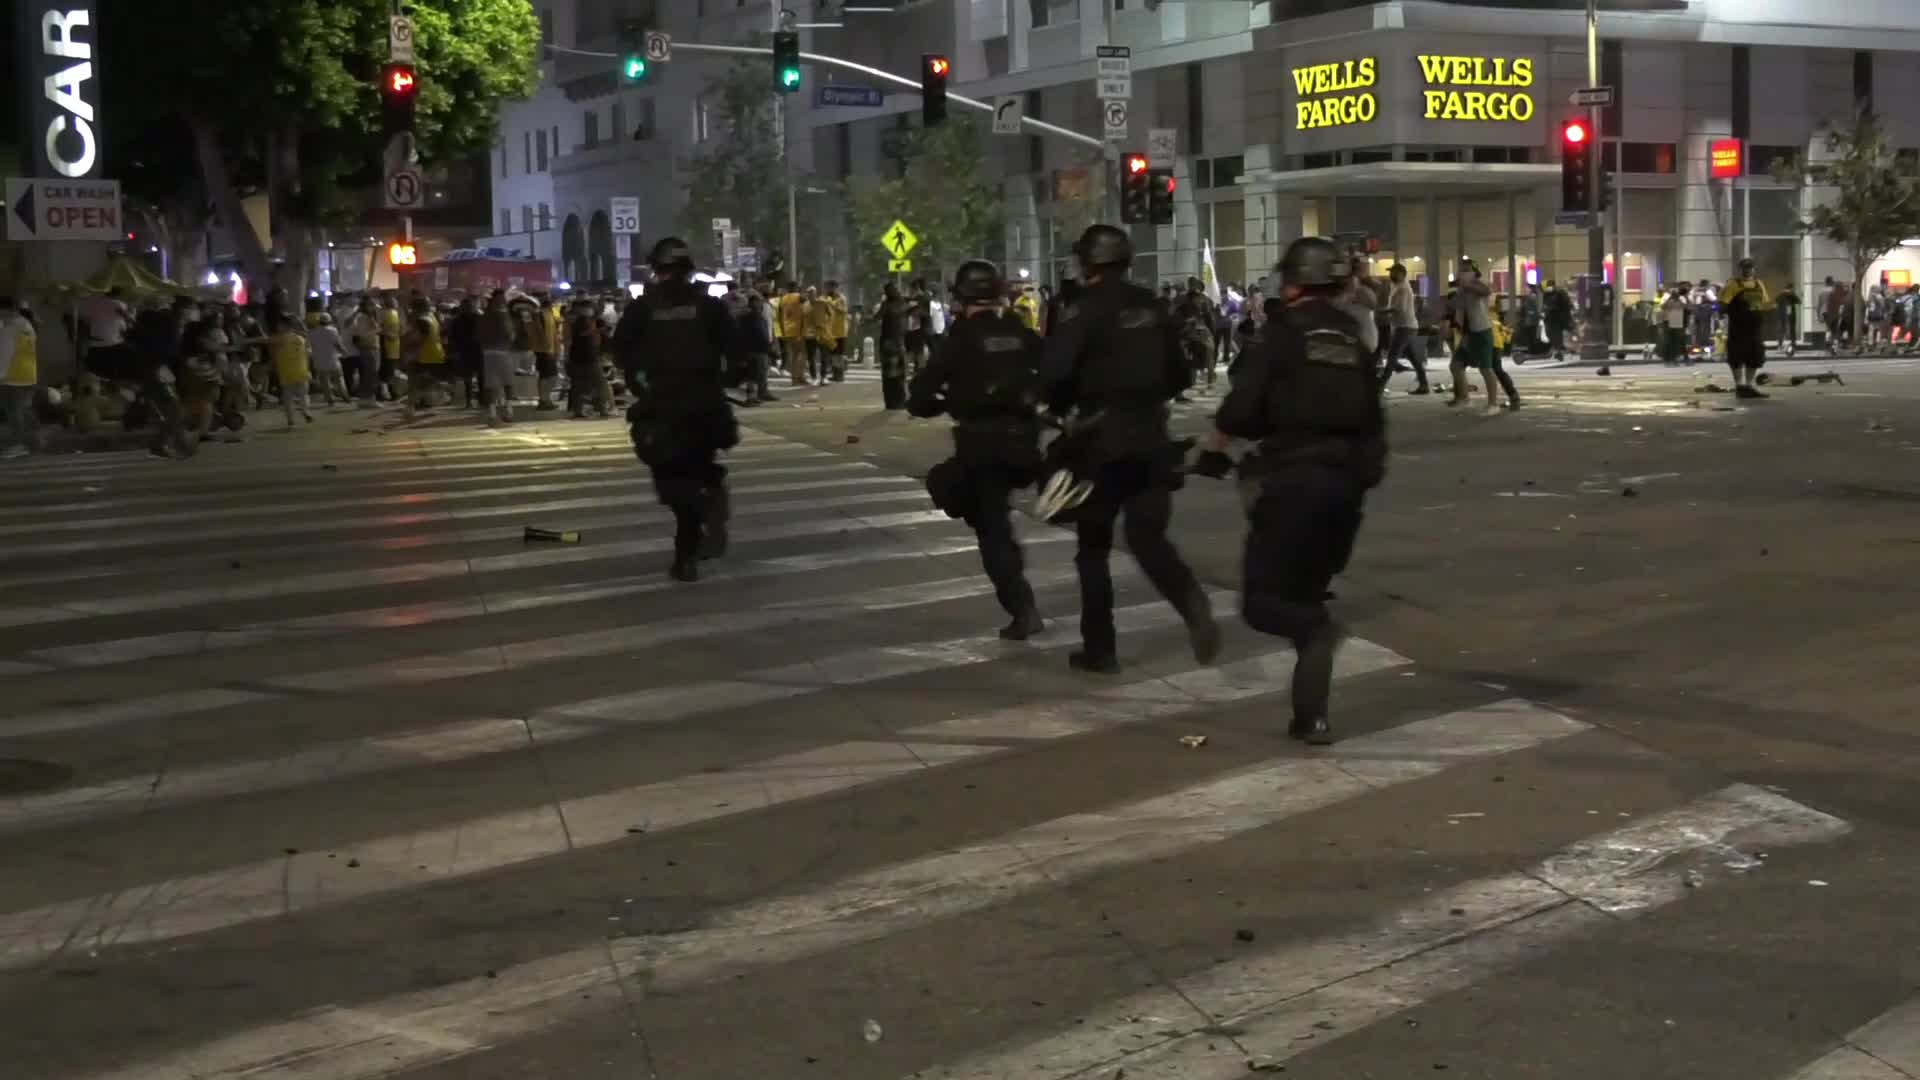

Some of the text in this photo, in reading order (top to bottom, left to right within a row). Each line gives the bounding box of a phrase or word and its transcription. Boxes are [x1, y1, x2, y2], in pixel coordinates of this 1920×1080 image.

[1292, 57, 1376, 95] WELLS
[1417, 55, 1534, 87] WELLS
[42, 9, 96, 178] CAR
[1423, 90, 1534, 121] FARGO
[1296, 93, 1376, 129] FARGO
[44, 187, 114, 200] CAR WASH
[47, 207, 117, 229] OPEN
[615, 216, 637, 230] 30
